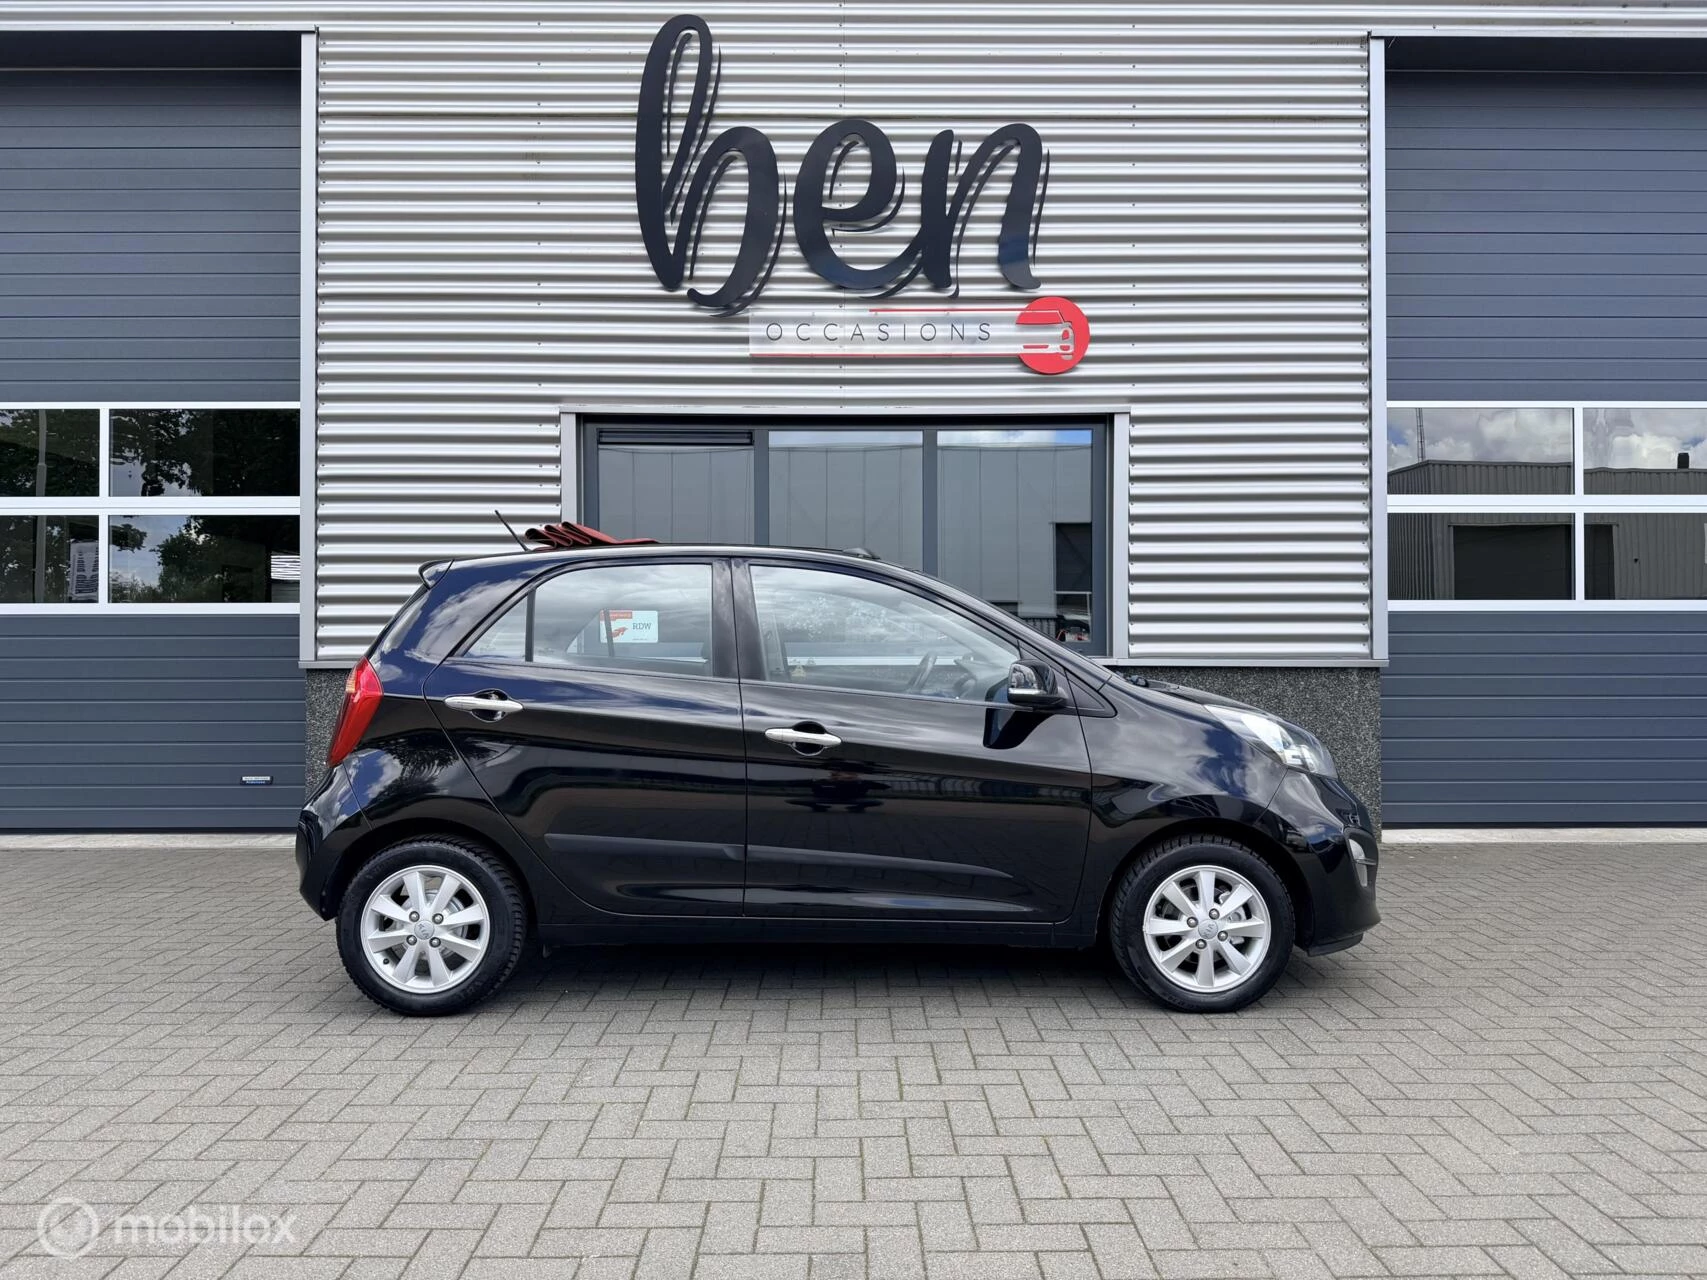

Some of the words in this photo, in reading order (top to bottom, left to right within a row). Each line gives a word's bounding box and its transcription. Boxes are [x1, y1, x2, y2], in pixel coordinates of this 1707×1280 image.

[635, 14, 1050, 317] ben
[765, 322, 991, 342] OCCASIONS
[631, 622, 652, 631] RDW
